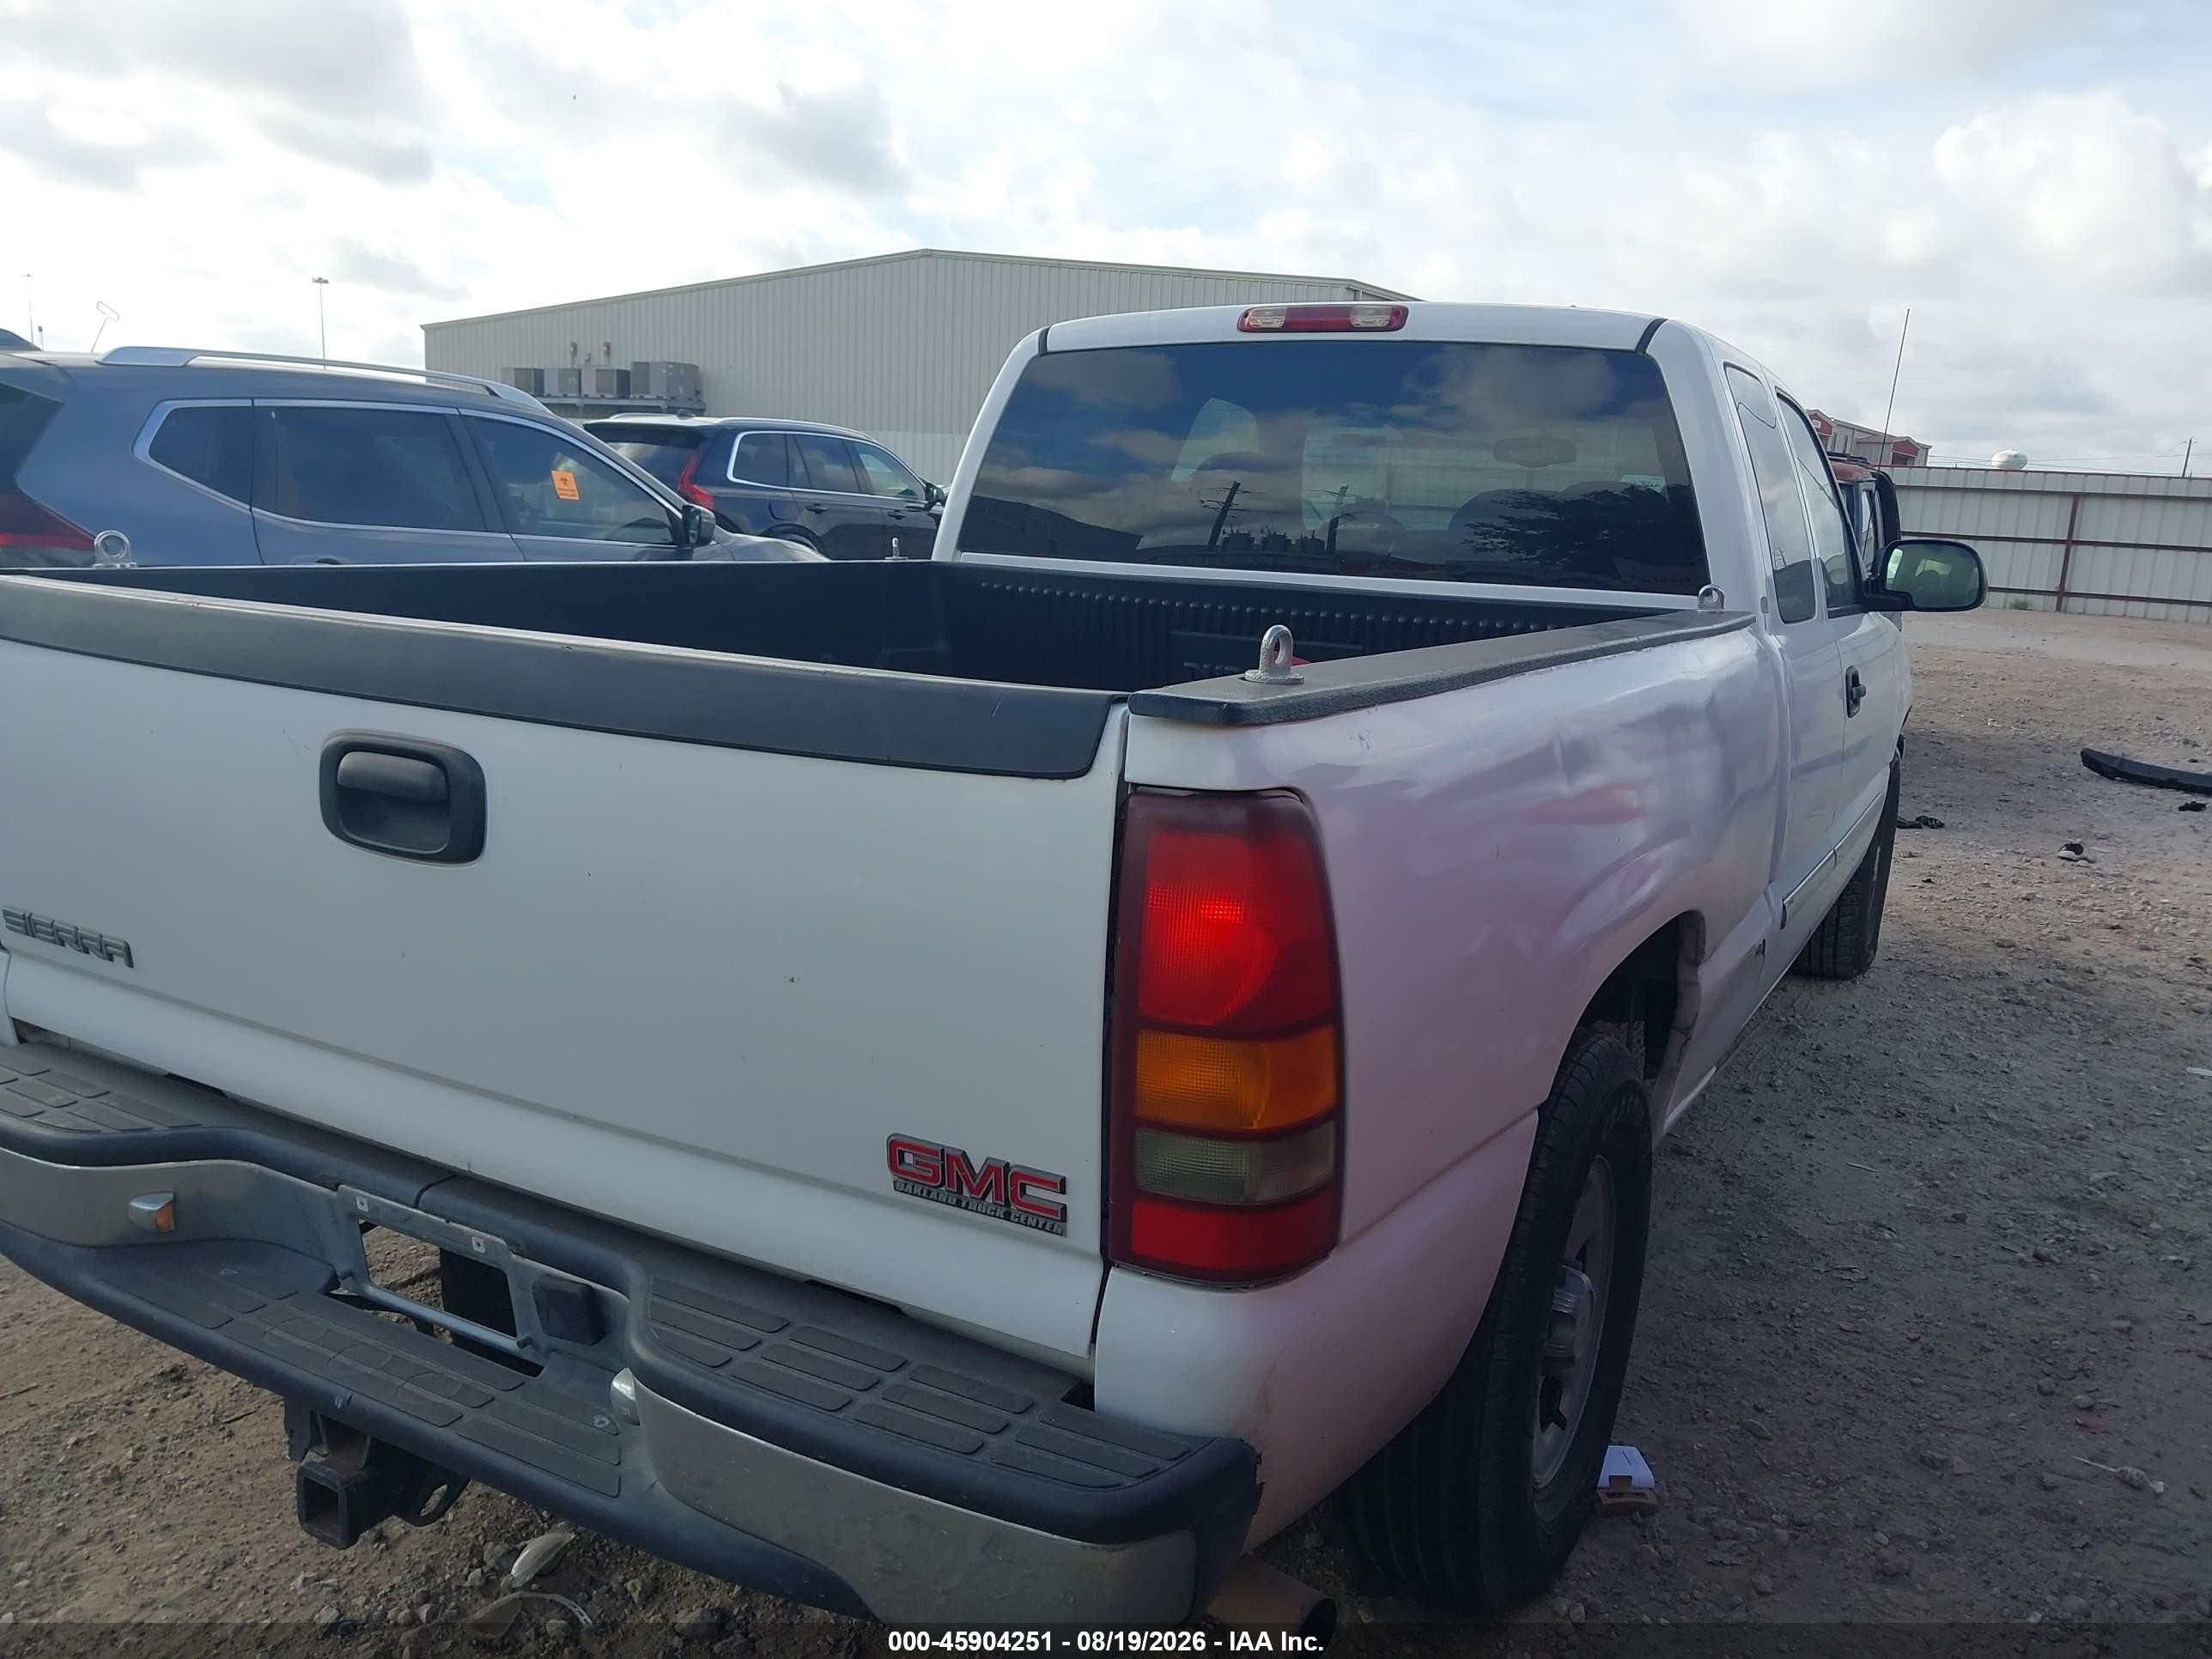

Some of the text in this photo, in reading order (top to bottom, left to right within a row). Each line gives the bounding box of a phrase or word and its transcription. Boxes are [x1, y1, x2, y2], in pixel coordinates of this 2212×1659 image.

[2, 907, 134, 969] SIERRA
[886, 1133, 1066, 1223] GMC
[961, 1199, 1005, 1219] TRUCK
[1010, 1211, 1063, 1234] CENTER
